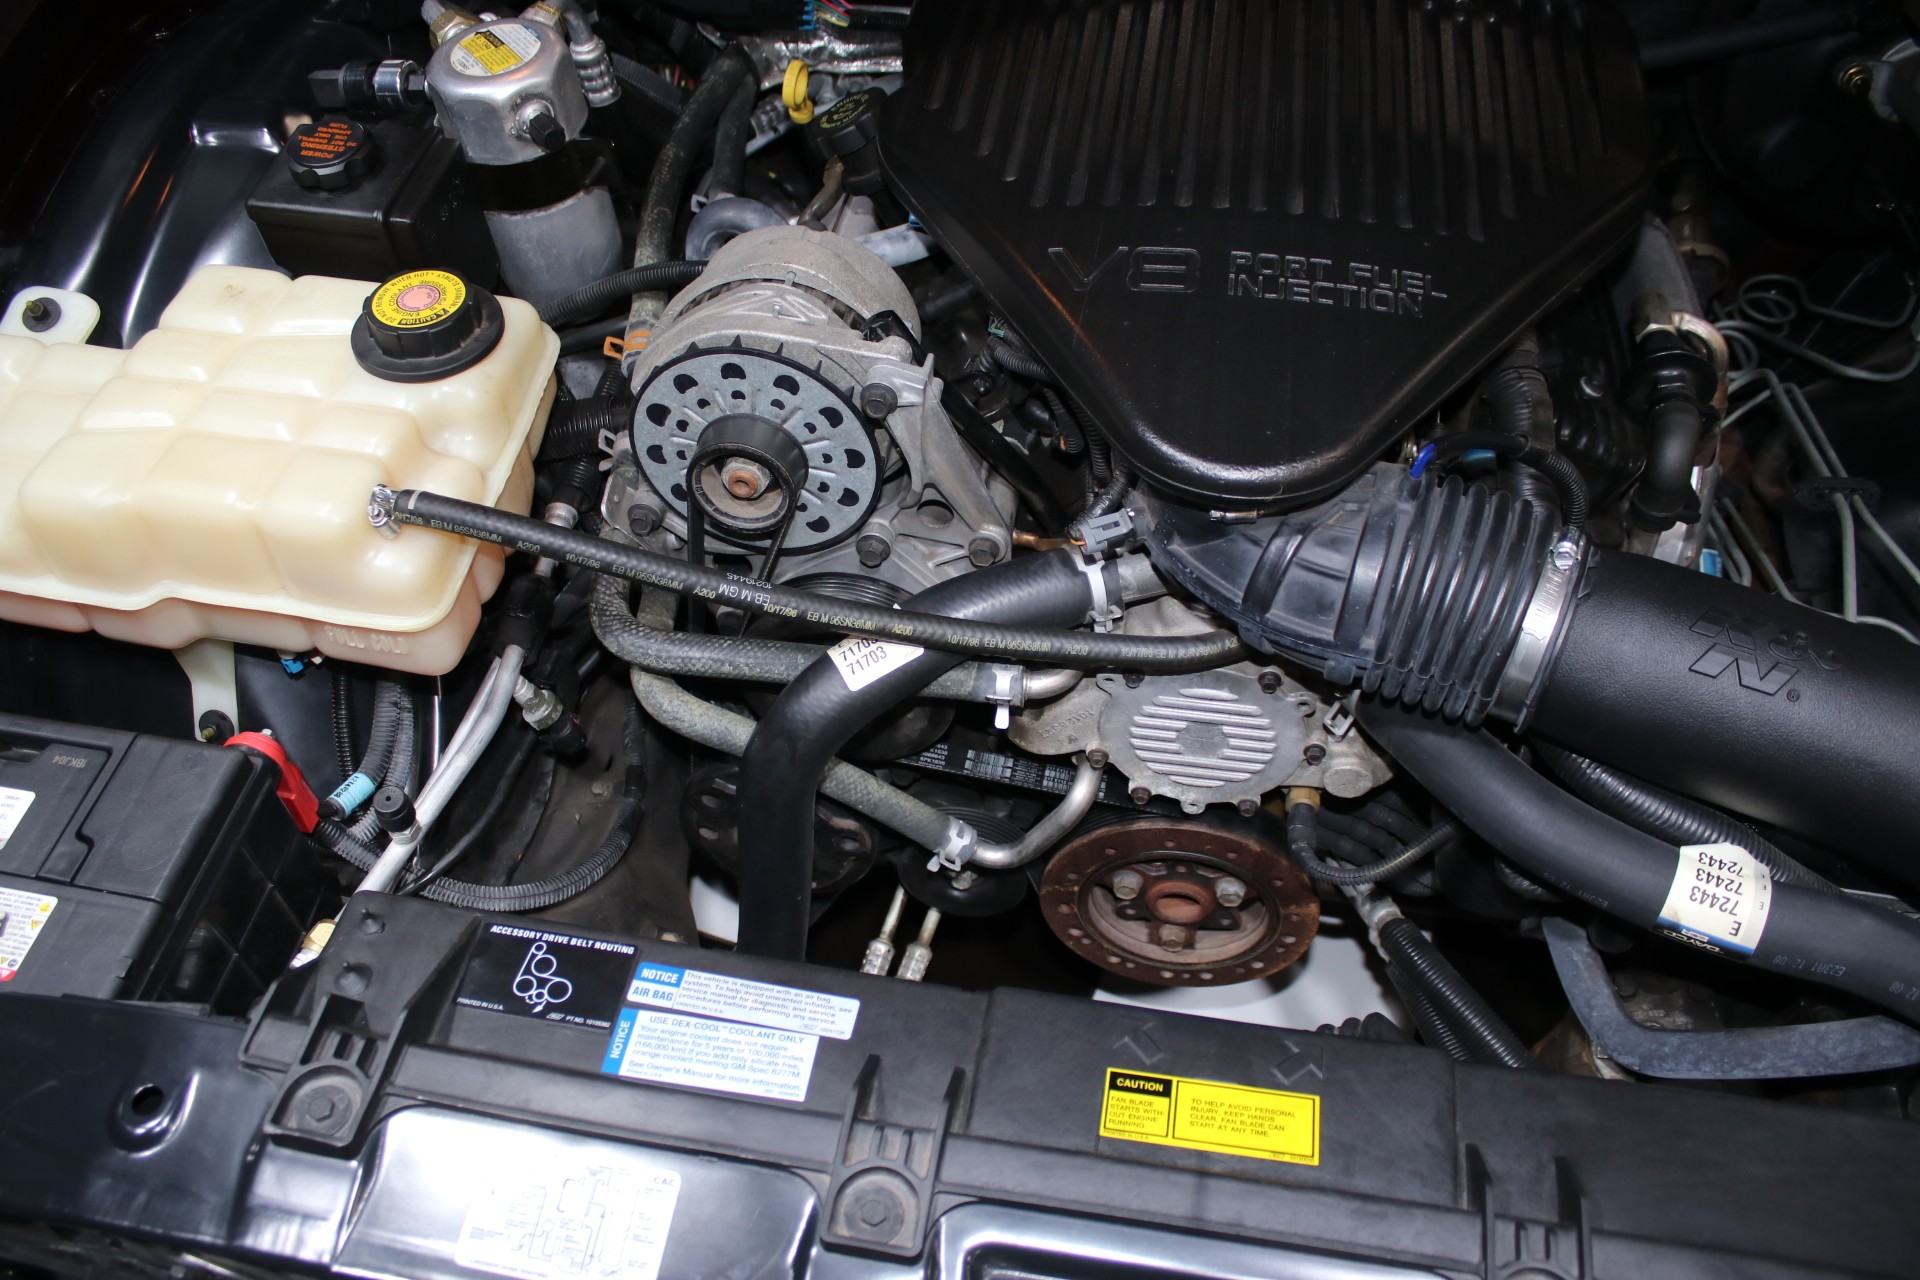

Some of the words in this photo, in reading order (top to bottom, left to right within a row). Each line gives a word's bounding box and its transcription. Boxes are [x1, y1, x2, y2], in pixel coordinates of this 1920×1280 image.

[300, 150, 334, 158] POWER
[301, 141, 346, 152] STEERING
[1048, 246, 1200, 293] V8
[1229, 250, 1332, 279] PORT
[1350, 262, 1447, 298] FUEL
[390, 275, 412, 286] WHEN
[1227, 273, 1424, 318] INJECTION
[400, 314, 437, 325] CAUTION
[718, 583, 739, 598] GM
[726, 572, 772, 590] 10219445
[516, 540, 540, 552] A200
[565, 552, 600, 569] 10/17/96
[693, 586, 716, 600] A200
[763, 603, 798, 618] 10/17/96
[892, 623, 913, 636] A200
[947, 634, 980, 648] 10/17/96
[1066, 644, 1088, 656] A200
[740, 589, 752, 601] M
[754, 593, 770, 606] EB
[846, 646, 888, 676] 71703
[1698, 851, 1744, 877] 72443
[1696, 868, 1743, 896] 72443
[1689, 885, 1739, 917] 72443
[1728, 920, 1742, 937] E
[490, 925, 542, 940] ACCESSORY
[542, 933, 569, 945] DRIVE
[570, 938, 593, 948] BELT
[594, 941, 635, 955] ROUTING
[1664, 929, 1721, 952] DAYCO
[641, 968, 679, 984] NOTICE
[632, 986, 650, 997] AIR
[652, 990, 673, 1001] BAG
[685, 980, 711, 989] system.
[726, 985, 742, 995] help
[766, 994, 802, 1005] unwanted
[805, 1001, 836, 1011] inflation,
[686, 972, 701, 980] This
[704, 975, 729, 984] vehicle
[740, 983, 774, 993] equipped
[816, 995, 831, 1004] bag
[457, 998, 481, 1007] PRINTED
[679, 993, 721, 1005] procedures
[723, 1001, 747, 1009] before
[749, 1007, 790, 1018] performing
[808, 1016, 836, 1025] service.
[682, 986, 707, 994] service
[710, 991, 737, 1000] manual
[752, 999, 790, 1010] diagnostic
[809, 1009, 836, 1017] service
[610, 1020, 631, 1059] NOTICE
[641, 1024, 658, 1033] Your
[660, 1028, 688, 1038] engine
[690, 1032, 720, 1042] coolant
[722, 1037, 742, 1046] does
[650, 1015, 669, 1025] USE
[729, 1027, 776, 1041] COOLANT
[779, 1034, 805, 1044] ONLY
[638, 1033, 689, 1047] maintenance
[692, 1039, 703, 1047] for
[712, 1044, 734, 1055] years
[748, 1048, 780, 1060] 100,000
[782, 1052, 804, 1062] miles
[672, 1045, 686, 1056] km)
[695, 1050, 710, 1060] you
[713, 1052, 729, 1060] add
[731, 1055, 748, 1065] only
[751, 1056, 780, 1067] silicate
[633, 1048, 660, 1060] orange
[663, 1053, 693, 1063] coolant
[696, 1058, 729, 1070] meeting
[748, 1064, 769, 1076] Spec
[628, 1060, 644, 1069] See
[646, 1062, 680, 1074] Owner's
[682, 1068, 713, 1079] Manual
[752, 1078, 802, 1091] information.
[1116, 1077, 1164, 1092] CAUTION
[1110, 1104, 1141, 1113] STARTS
[1142, 1108, 1166, 1116] WITH-
[1111, 1096, 1127, 1104] FAN
[1128, 1098, 1154, 1108] BLADE
[1205, 1100, 1226, 1108] HELP
[1228, 1103, 1252, 1112] AVOID
[1255, 1106, 1296, 1118] PERSONAL
[1108, 1118, 1145, 1130] RUNNING
[1109, 1111, 1126, 1120] OUT
[1128, 1114, 1158, 1124] ENGINE
[1190, 1121, 1215, 1130] START
[1224, 1110, 1245, 1118] KEEP
[1248, 1113, 1275, 1122] HANDS
[1239, 1119, 1266, 1129] BLADE
[1268, 1123, 1285, 1132] CAN
